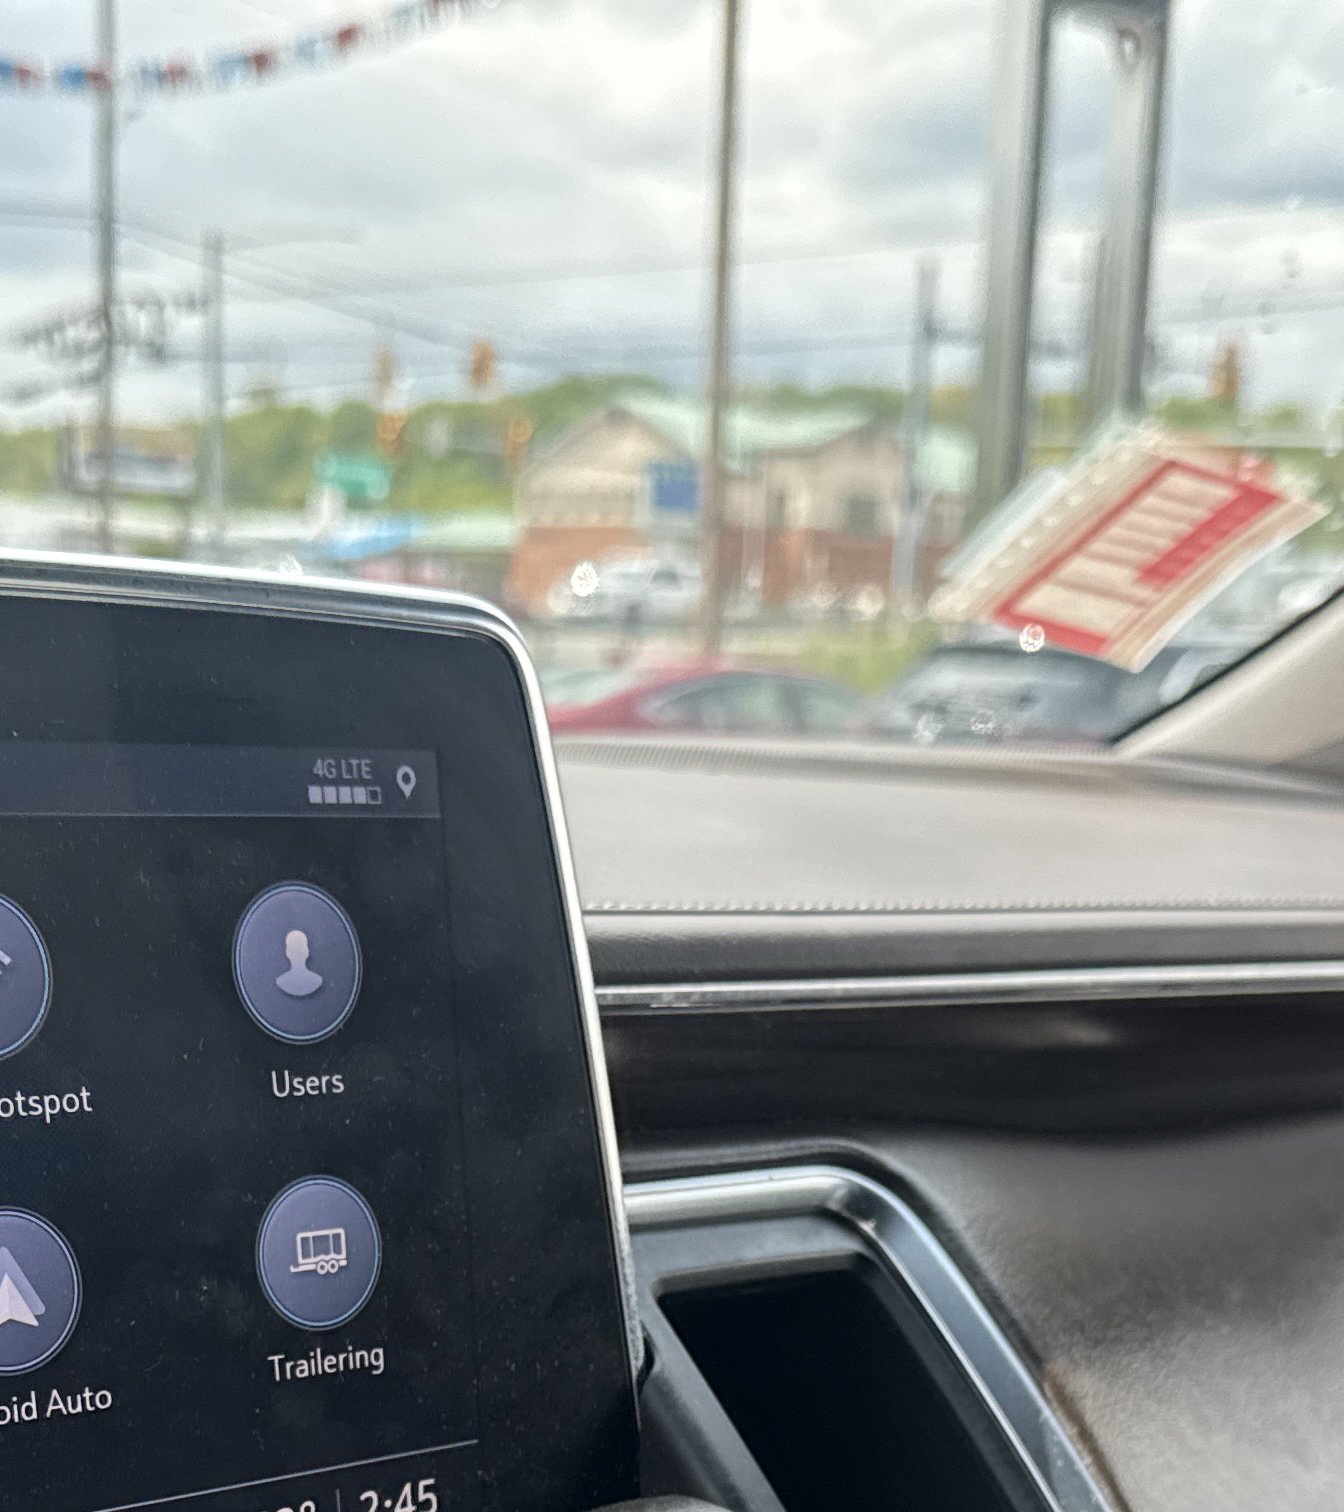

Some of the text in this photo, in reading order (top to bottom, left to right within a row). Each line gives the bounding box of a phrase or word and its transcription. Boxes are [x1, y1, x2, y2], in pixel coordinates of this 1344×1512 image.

[312, 758, 373, 780] 4G LTE
[271, 1069, 345, 1098] Users
[267, 1345, 385, 1382] Trailering
[46, 1386, 113, 1418] Auto
